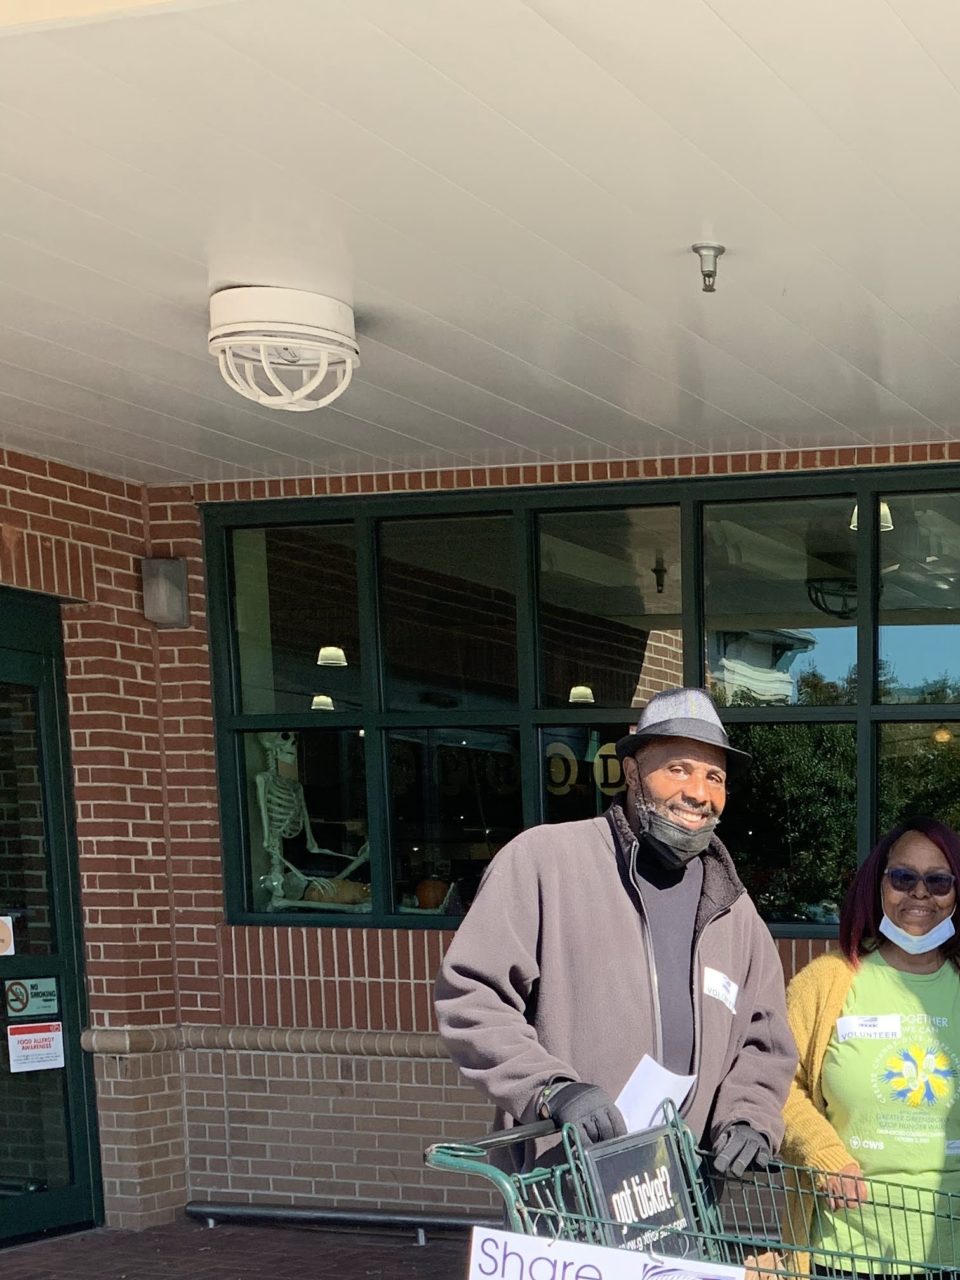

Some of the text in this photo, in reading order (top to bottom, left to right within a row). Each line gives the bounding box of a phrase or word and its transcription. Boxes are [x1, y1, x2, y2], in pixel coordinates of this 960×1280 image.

[30, 990, 56, 998] SMOKING
[900, 1014, 948, 1027] OGETHER
[841, 1031, 897, 1040] VOLUNTEER
[862, 1140, 885, 1150] CWS
[612, 1179, 639, 1235] got
[630, 1165, 675, 1220] ticket?
